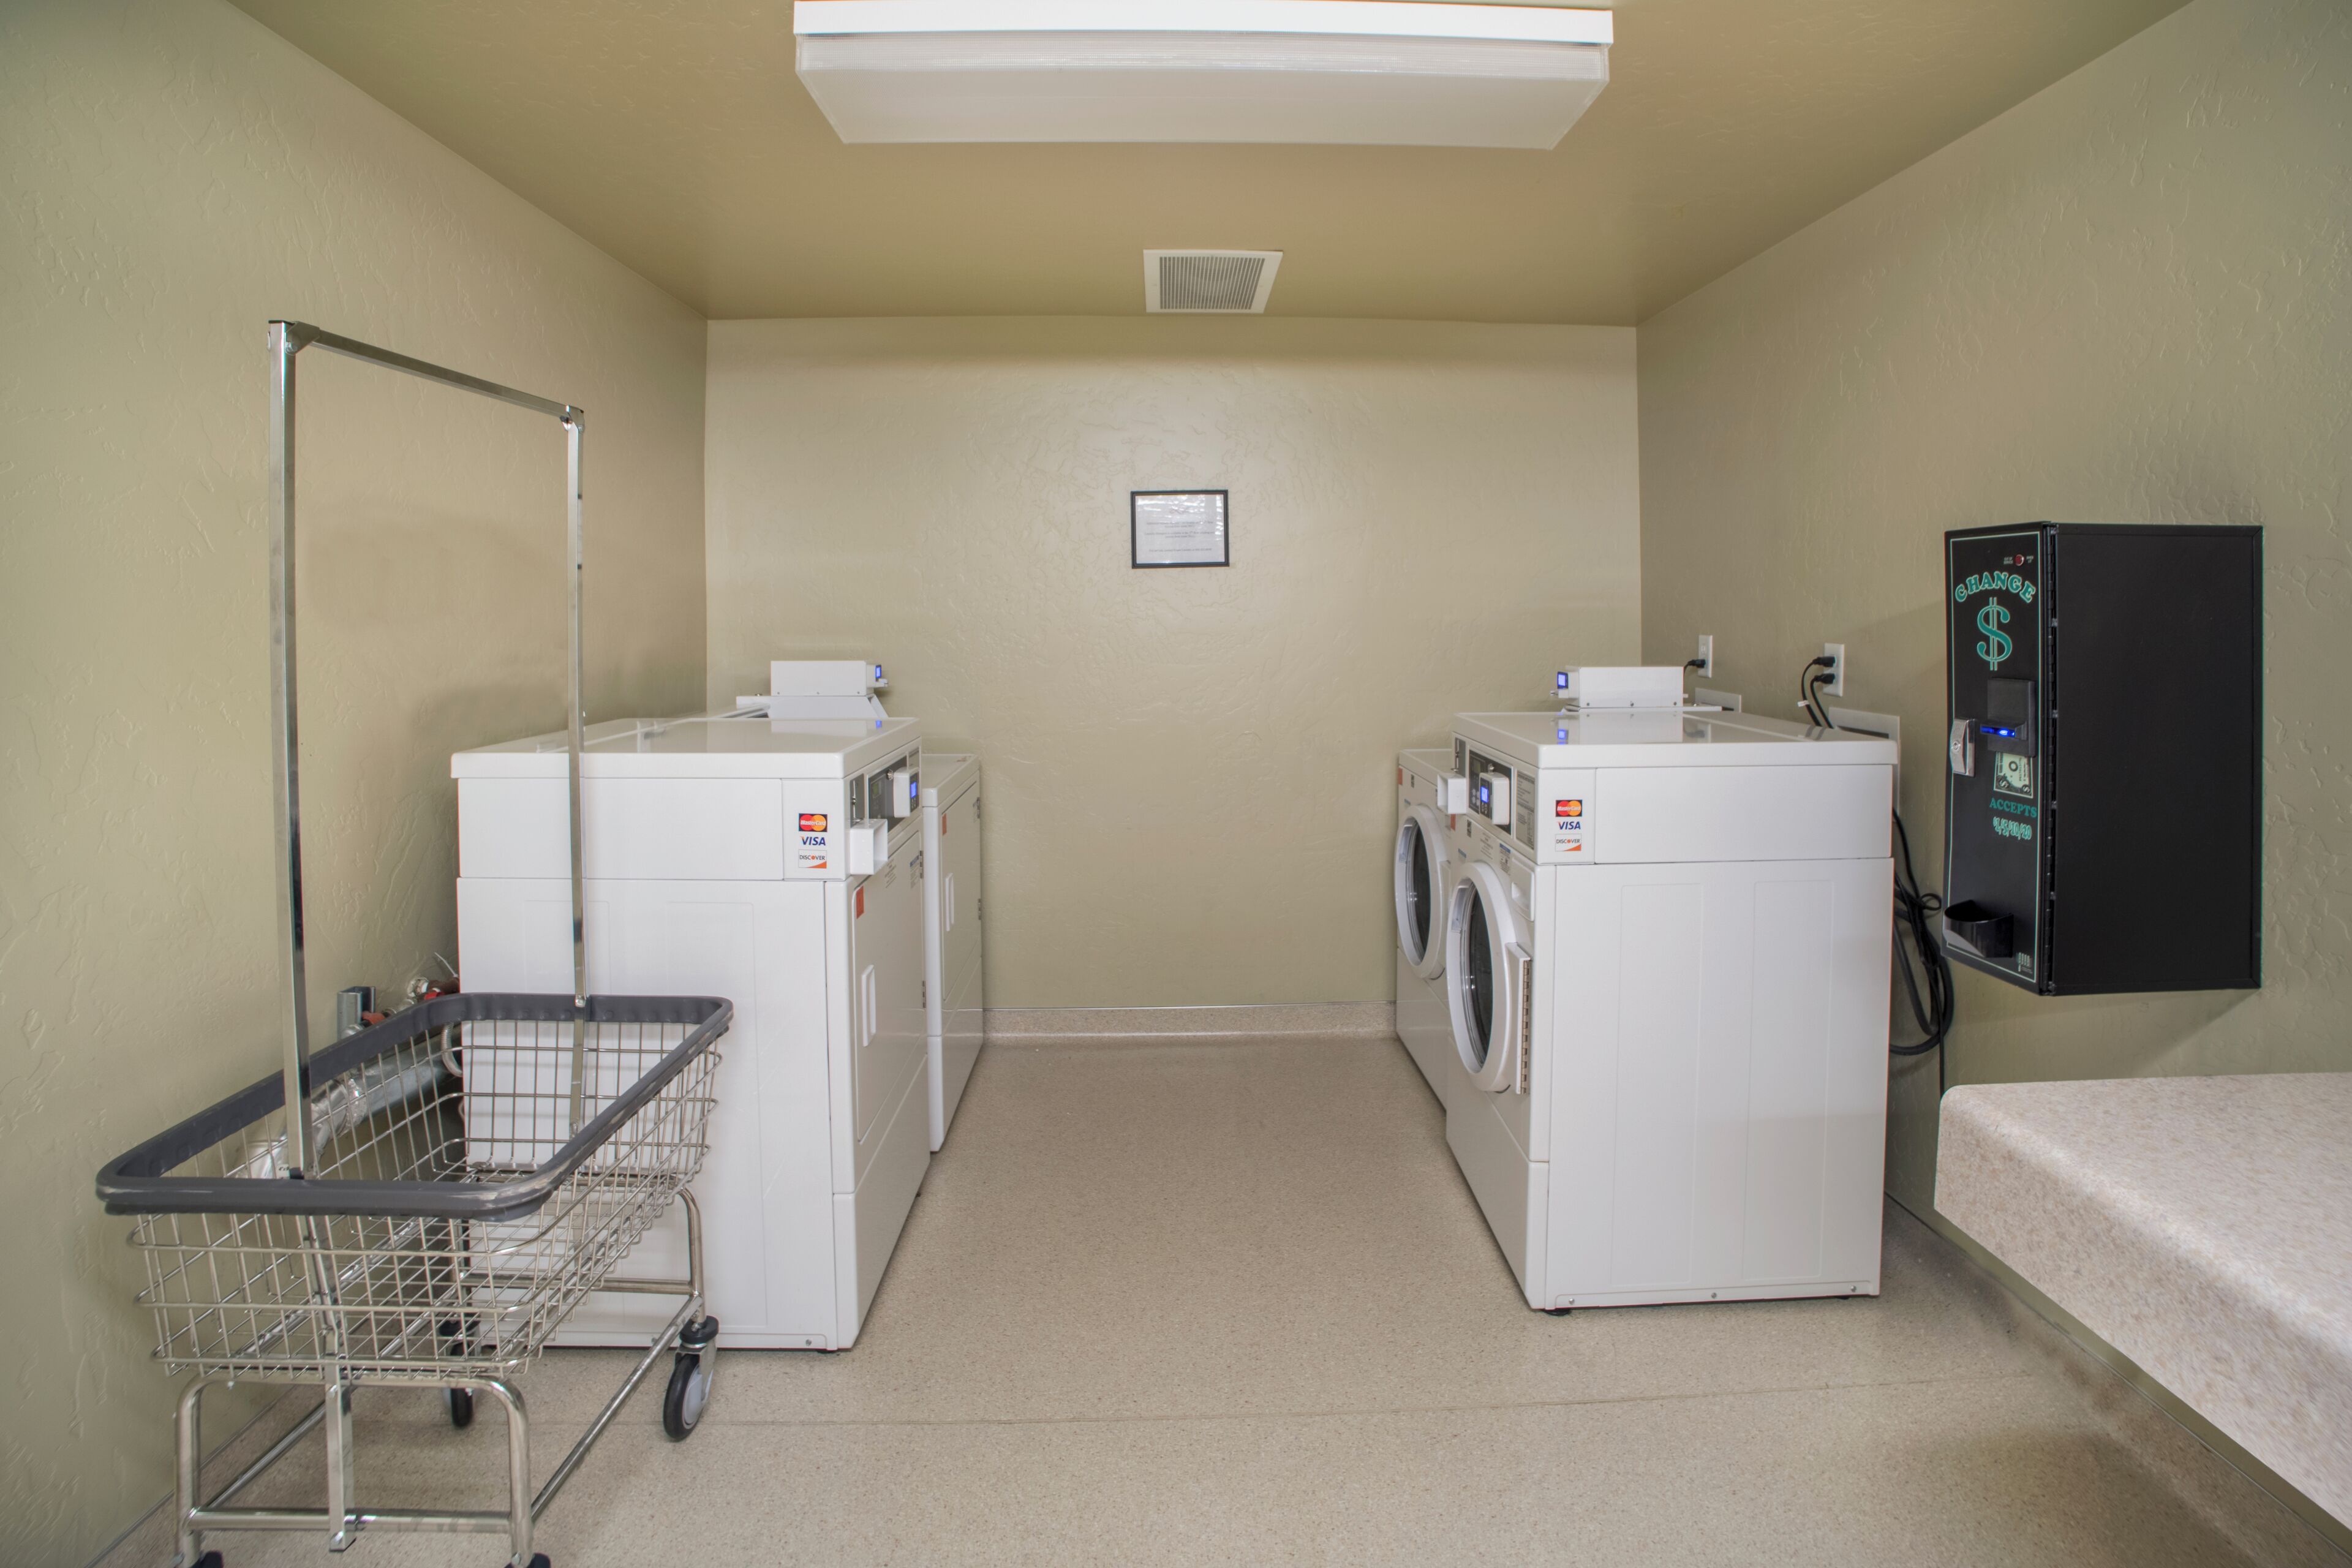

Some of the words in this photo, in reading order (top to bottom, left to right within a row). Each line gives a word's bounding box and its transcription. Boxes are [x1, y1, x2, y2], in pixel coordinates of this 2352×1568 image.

[1955, 571, 2036, 603] CHANGE
[1977, 597, 2013, 671] $
[1989, 797, 2037, 818] ACCEPTS
[1558, 821, 1581, 830] VISA
[800, 835, 826, 846] VISA
